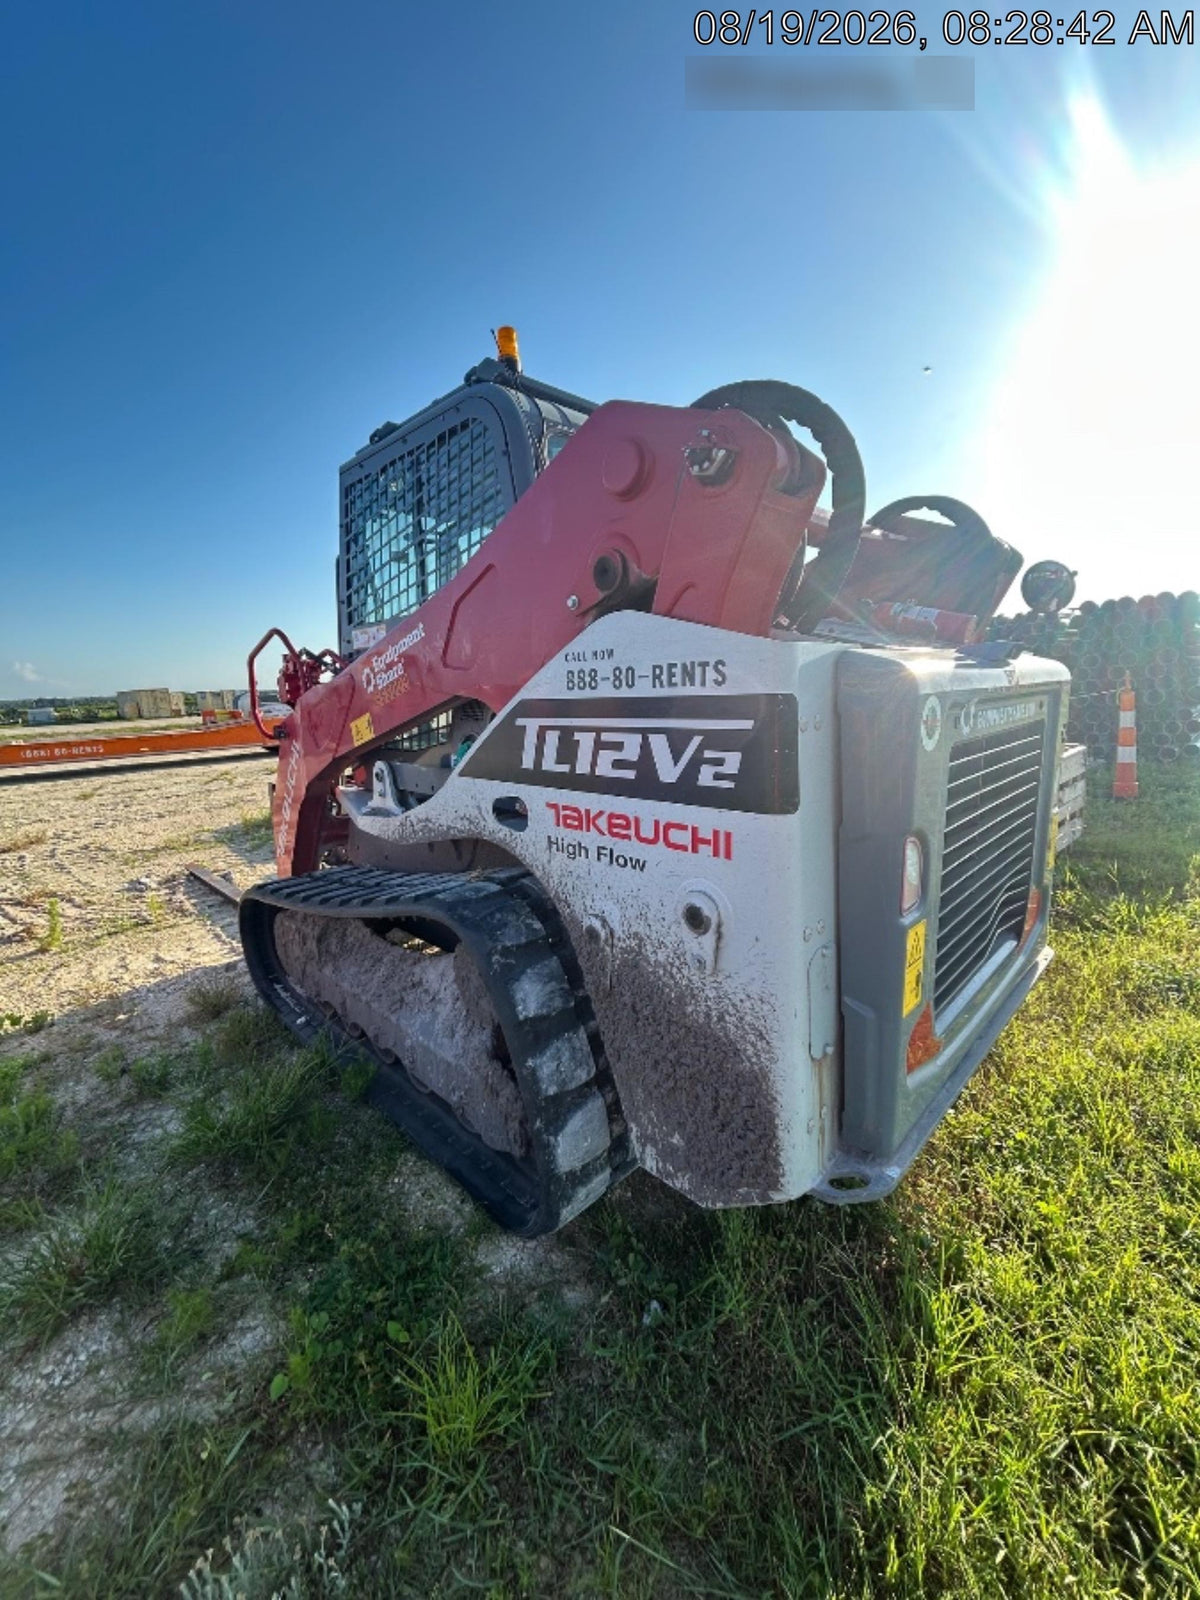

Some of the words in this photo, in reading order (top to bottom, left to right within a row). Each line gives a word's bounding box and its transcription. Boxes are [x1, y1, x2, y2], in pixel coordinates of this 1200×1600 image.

[564, 650, 588, 663] CALL
[591, 648, 615, 661] NOW
[566, 659, 727, 690] 888-80-RENTS
[515, 717, 755, 789] TL12V2
[546, 836, 590, 860] High
[596, 849, 647, 873] Flow
